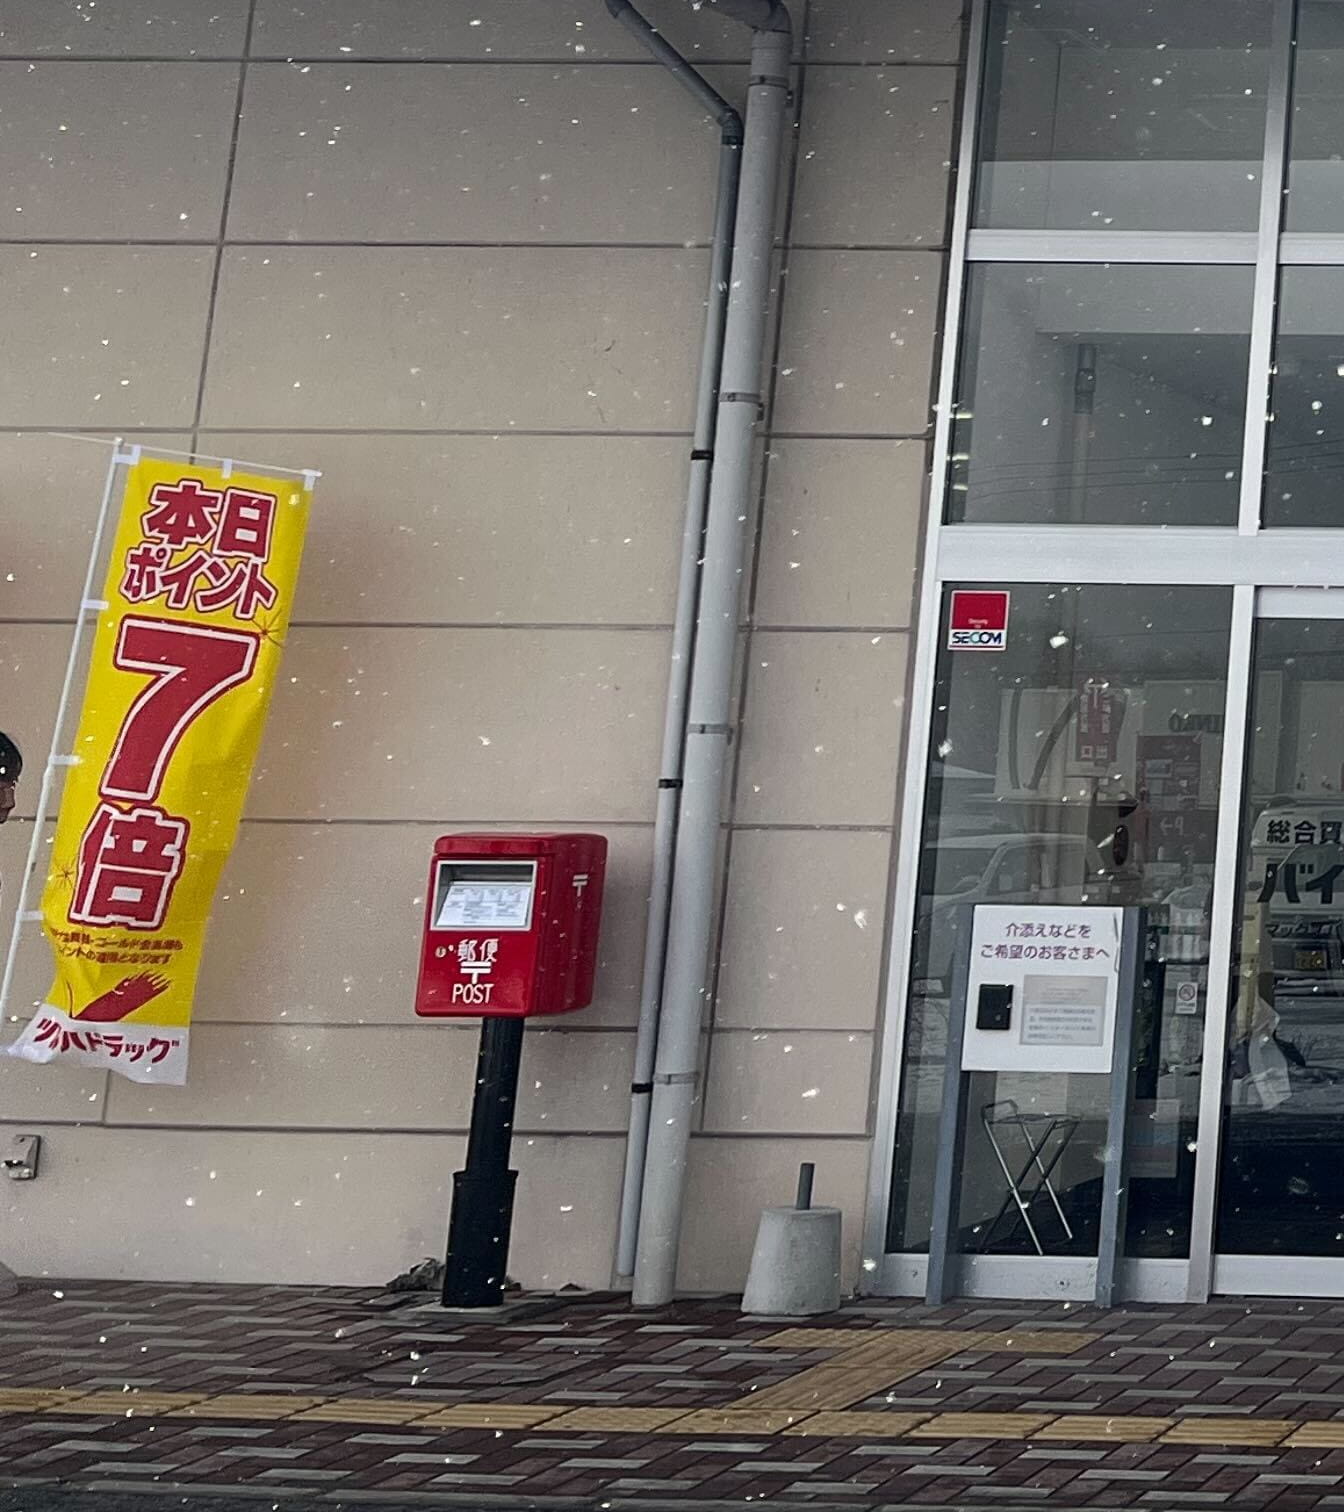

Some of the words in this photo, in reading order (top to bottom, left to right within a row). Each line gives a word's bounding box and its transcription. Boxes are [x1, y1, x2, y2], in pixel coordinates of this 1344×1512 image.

[141, 478, 277, 563] 本日
[120, 542, 278, 619] ポイント
[952, 631, 1002, 644] SECOM
[1005, 922, 1092, 938] 介添えなどを
[458, 938, 499, 962] 郵便
[980, 944, 1110, 960] ご希望のお客さまへ
[452, 983, 494, 1004] POST
